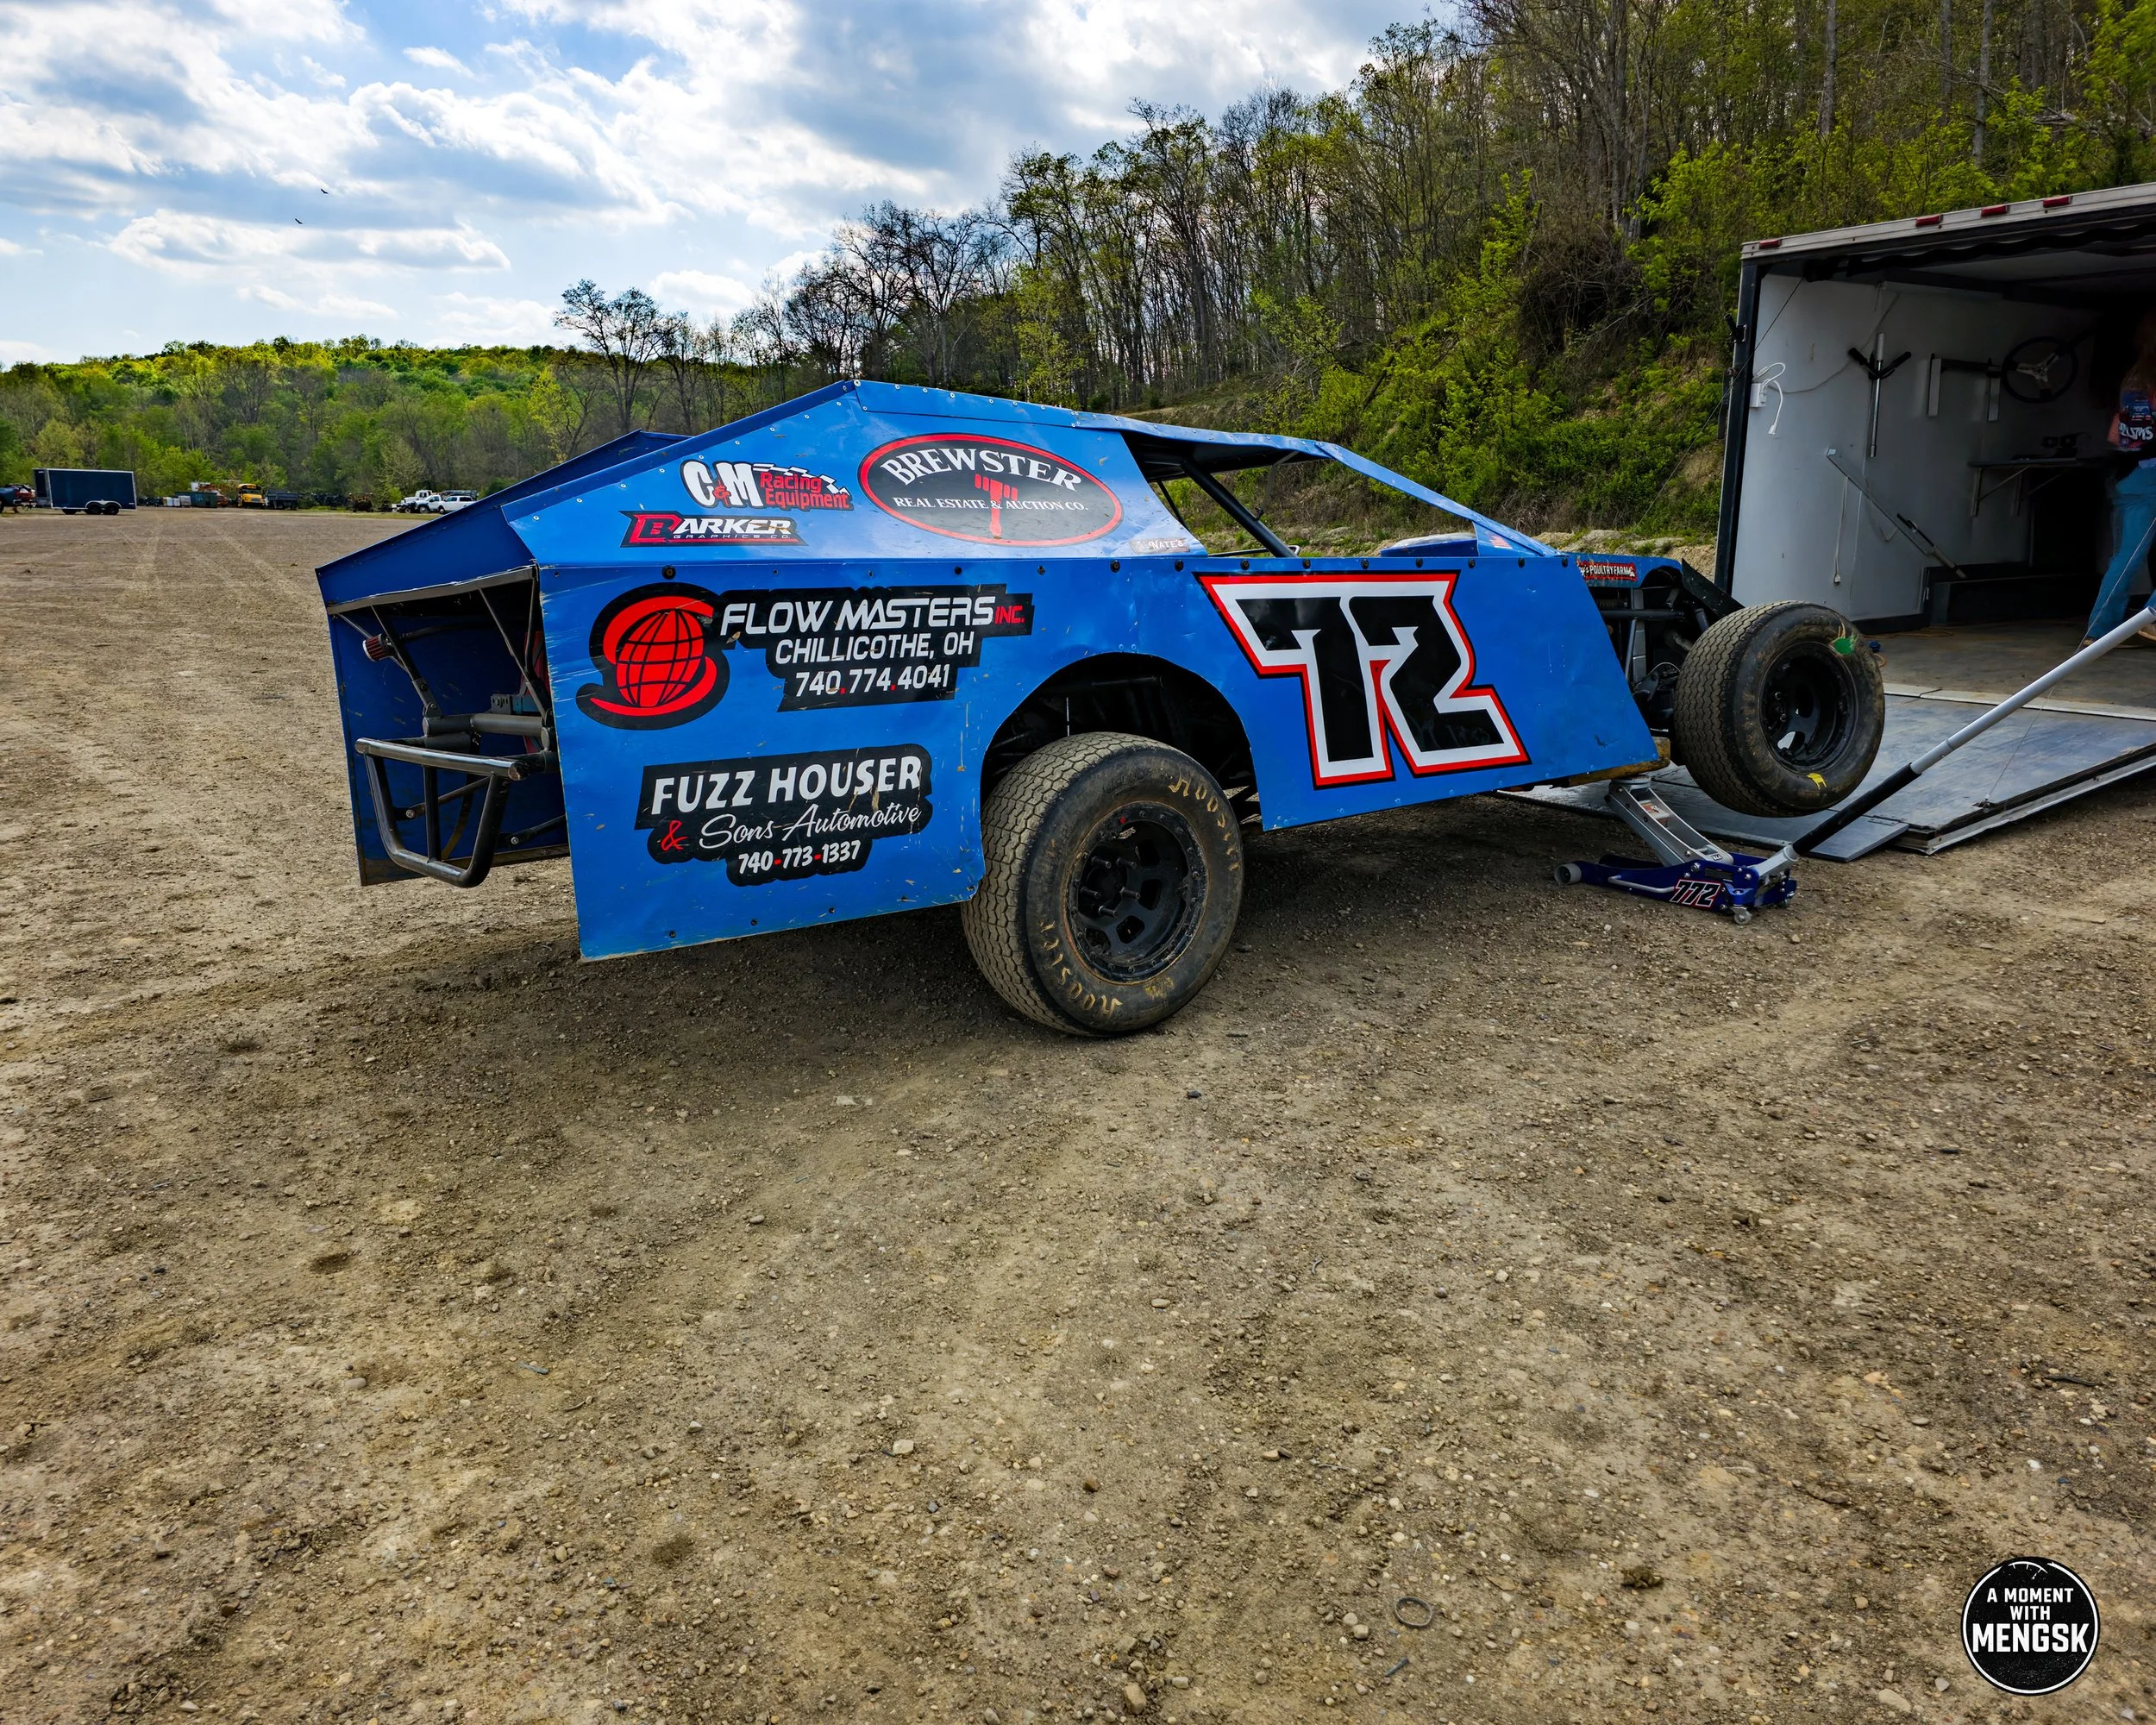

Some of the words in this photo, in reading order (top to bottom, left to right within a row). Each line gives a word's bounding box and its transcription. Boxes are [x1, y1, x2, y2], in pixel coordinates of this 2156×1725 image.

[681, 461, 764, 508] C&M
[760, 472, 822, 493] Racing
[880, 448, 1081, 492] BREWSTER
[765, 488, 849, 509] Equipment
[893, 497, 936, 508] REAL
[937, 499, 988, 510] ESTATE
[991, 499, 1002, 510] &
[1006, 500, 1064, 511] AUCTION
[1066, 501, 1088, 511] CO.
[630, 514, 792, 543] BARKER
[1589, 565, 1614, 575] POULTRY
[719, 600, 833, 637] FLOW
[835, 596, 997, 630] MASTERS
[994, 605, 1025, 624] INC.
[775, 634, 935, 665] CHILLICOTHE,
[943, 631, 975, 655] OH
[795, 664, 950, 697] 740.774.4041
[1197, 573, 1530, 787] 72
[651, 770, 754, 815] FUZZ
[768, 756, 923, 805] HOUSER
[661, 820, 687, 851] &
[699, 813, 774, 850] Sons
[775, 803, 922, 840] Automotive
[738, 840, 862, 875] 740-773-1337
[1670, 880, 1721, 907] 772
